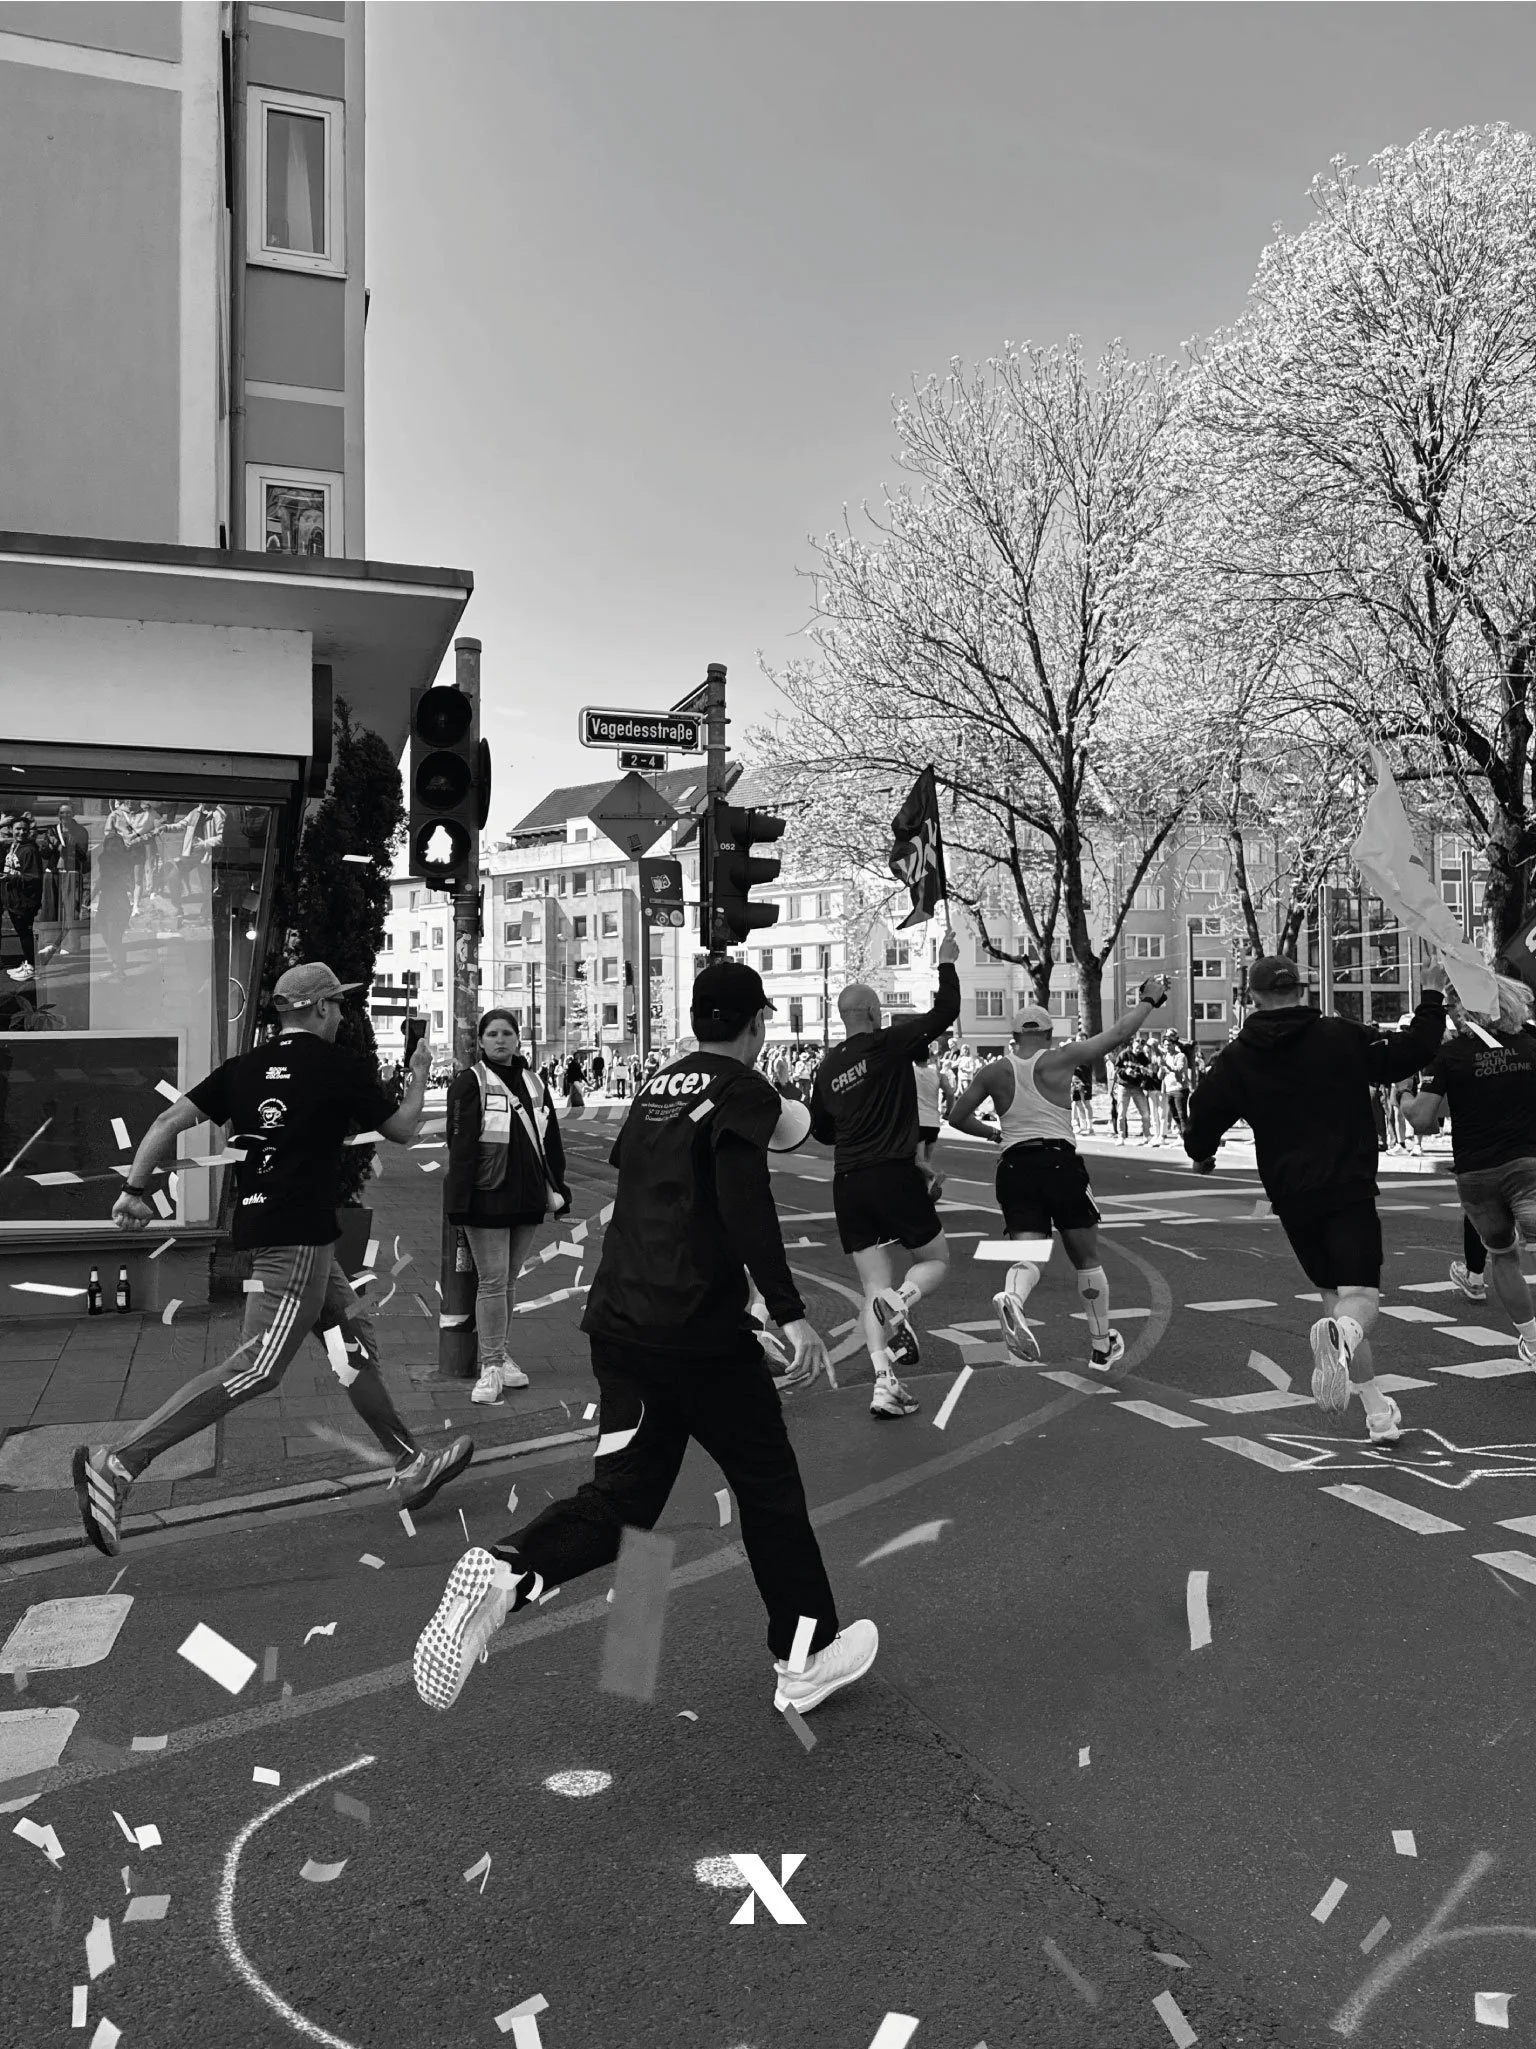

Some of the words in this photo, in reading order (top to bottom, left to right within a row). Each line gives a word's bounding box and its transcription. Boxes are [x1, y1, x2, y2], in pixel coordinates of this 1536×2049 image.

[591, 718, 694, 741] Vagedesstraße
[720, 843, 736, 851] 052
[1475, 1048, 1520, 1061] SOCIAL
[831, 1059, 868, 1092] CREW
[1474, 1062, 1532, 1077] COLOGNE
